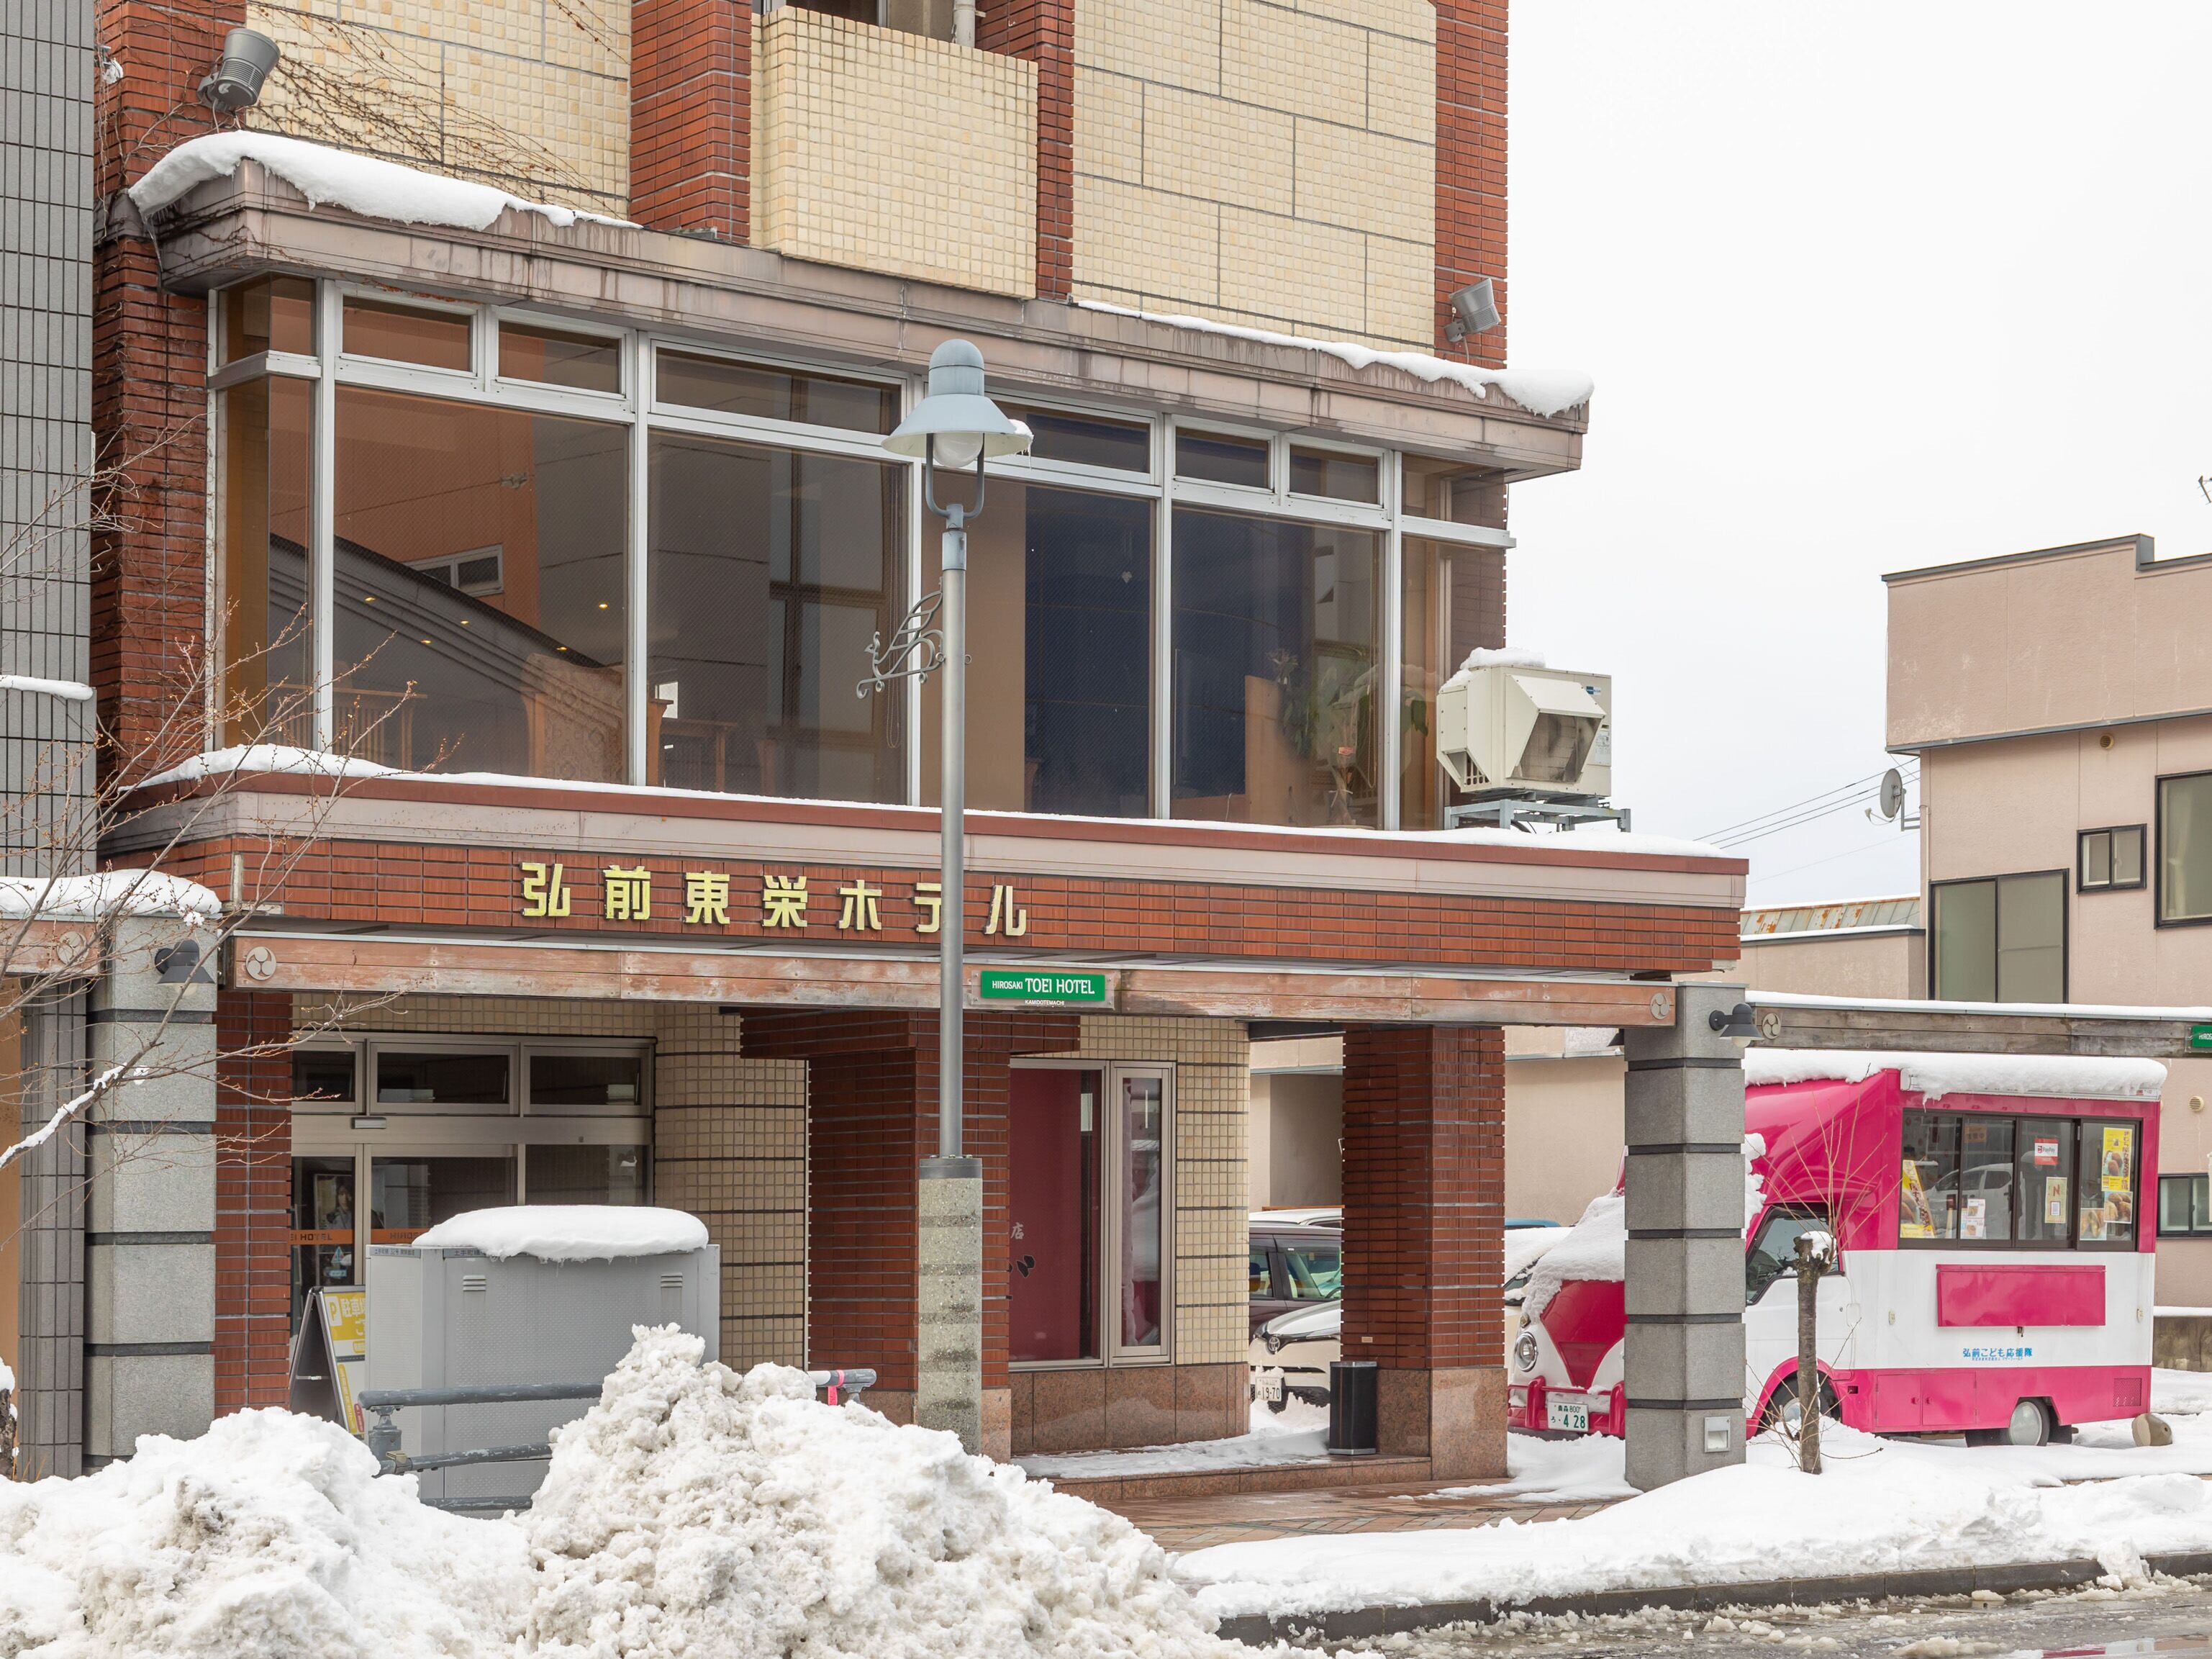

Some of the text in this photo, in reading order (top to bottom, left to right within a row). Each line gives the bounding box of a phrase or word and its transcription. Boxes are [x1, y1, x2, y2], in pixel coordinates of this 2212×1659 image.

[992, 977, 1095, 995] HIROSAKI TOEI HOTEL
[1962, 1347, 2033, 1357] 弘前こども応援隊
[1262, 1387, 1280, 1400] 19-70
